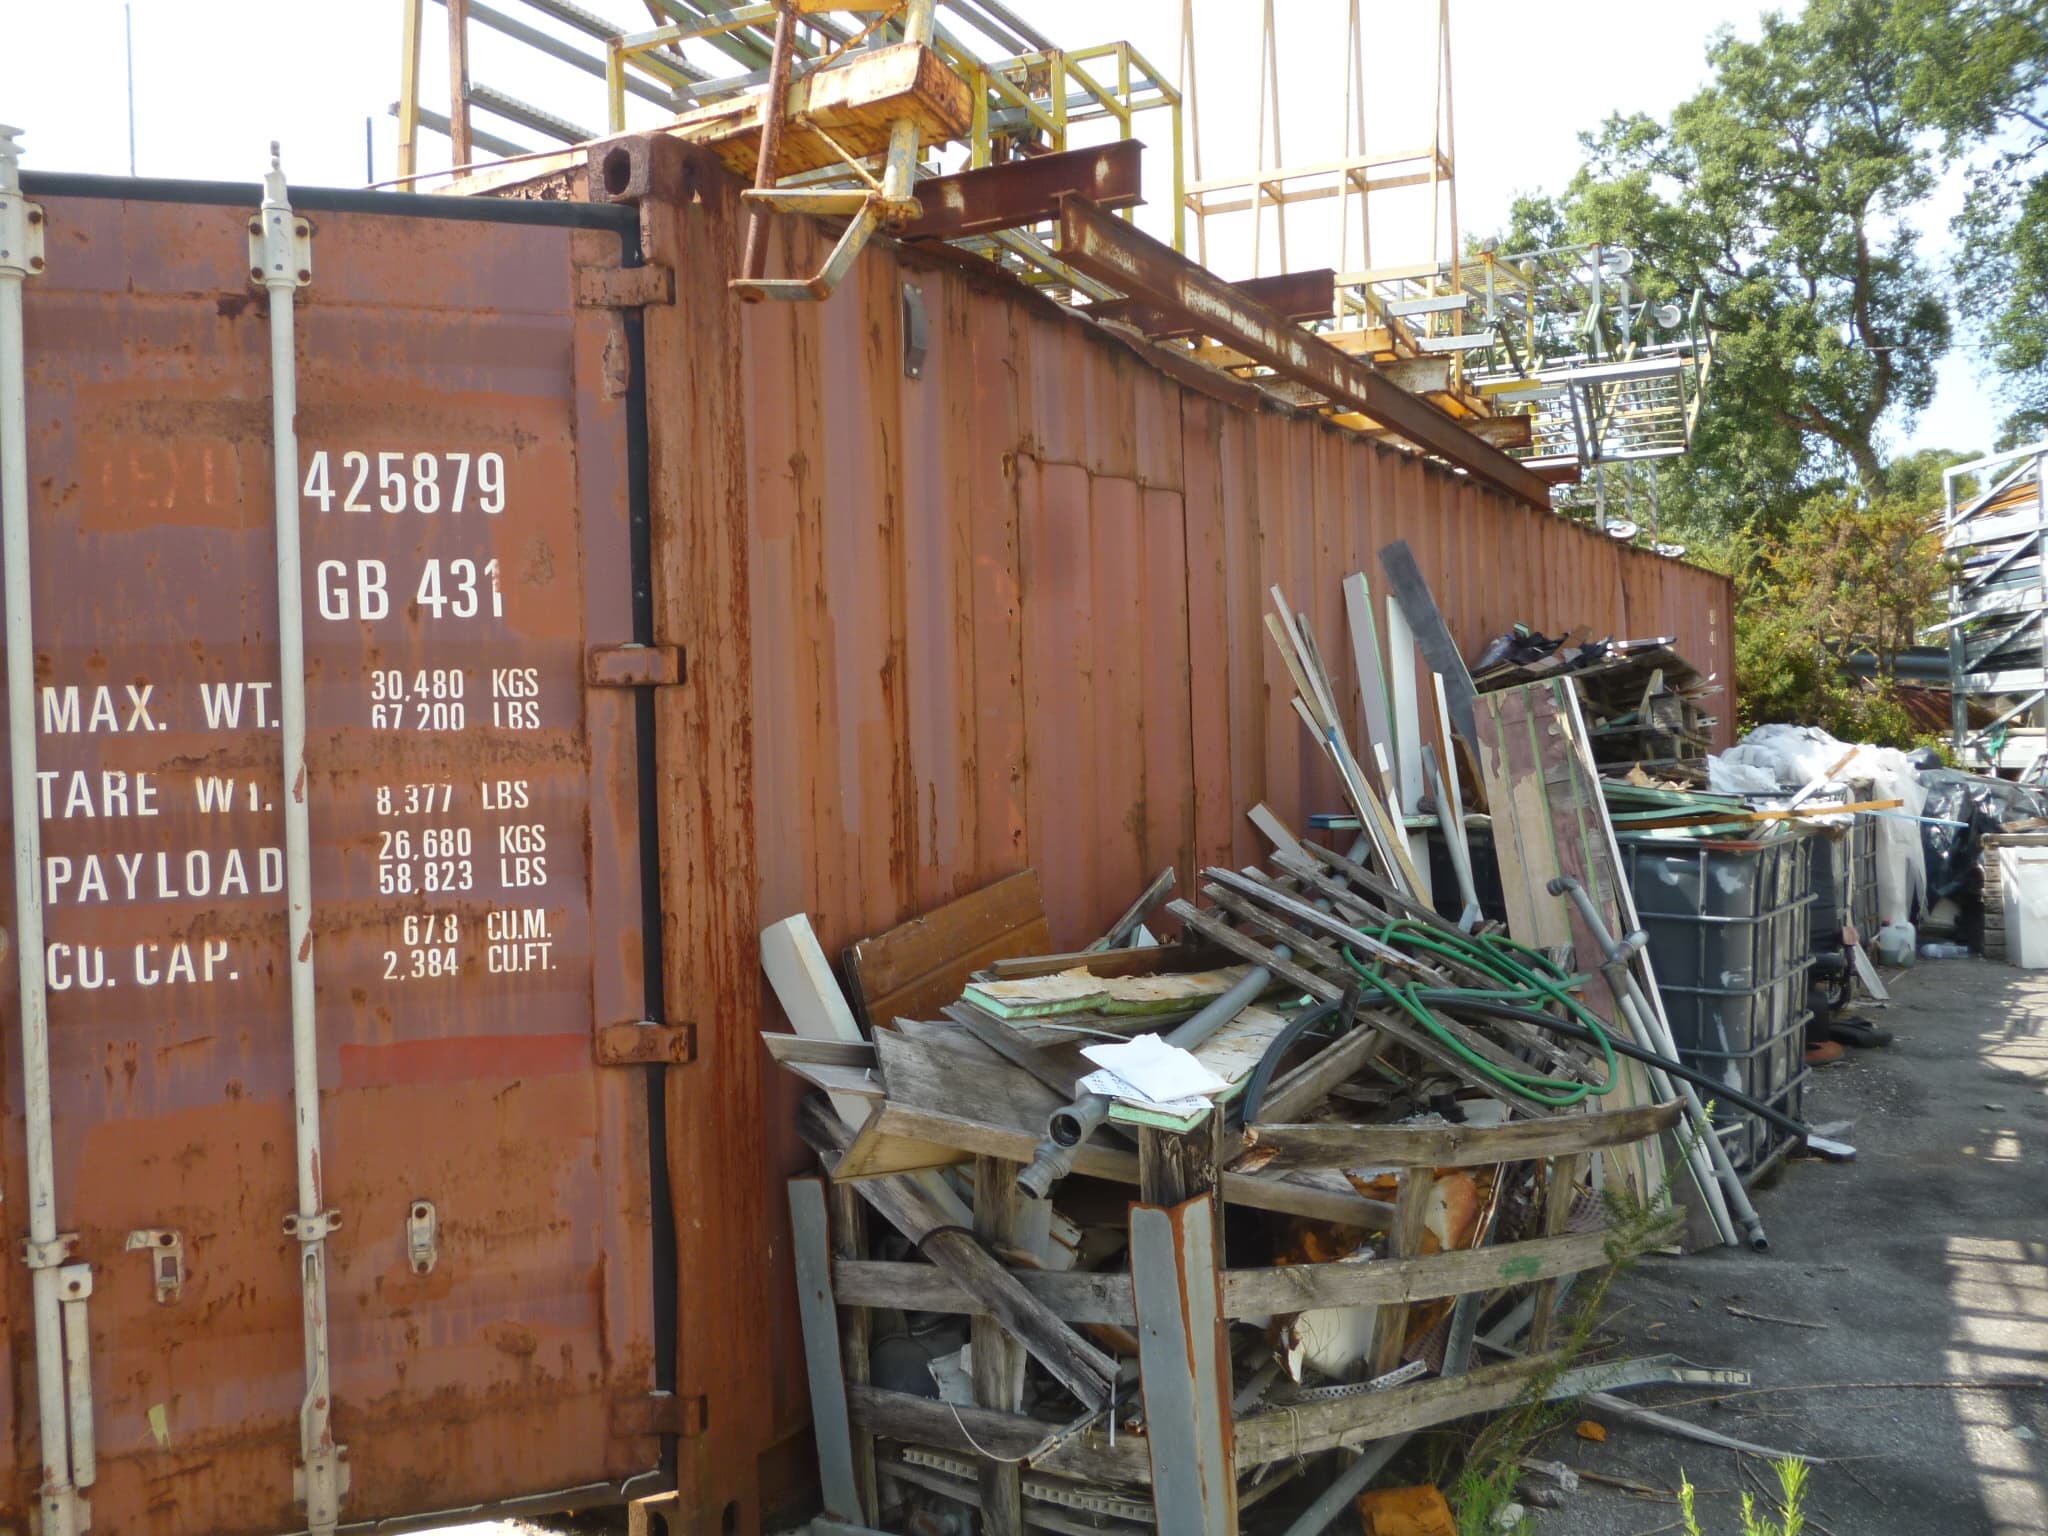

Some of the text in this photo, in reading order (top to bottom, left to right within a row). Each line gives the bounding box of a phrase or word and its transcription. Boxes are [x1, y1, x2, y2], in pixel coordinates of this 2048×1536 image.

[303, 451, 505, 514] 425879
[317, 558, 503, 620] GB 431
[371, 668, 539, 701] 30,480 KGS
[42, 682, 280, 733] MAX. WT.
[37, 770, 159, 819] TARE
[482, 780, 529, 810] LBS
[379, 824, 547, 861] 26,680 KGS
[46, 847, 284, 904] PAYLOAD
[379, 856, 548, 895] 58,823 LBS
[403, 913, 459, 945] 67.8
[47, 938, 239, 991] CU. CAP.
[383, 947, 458, 981] 2,384
